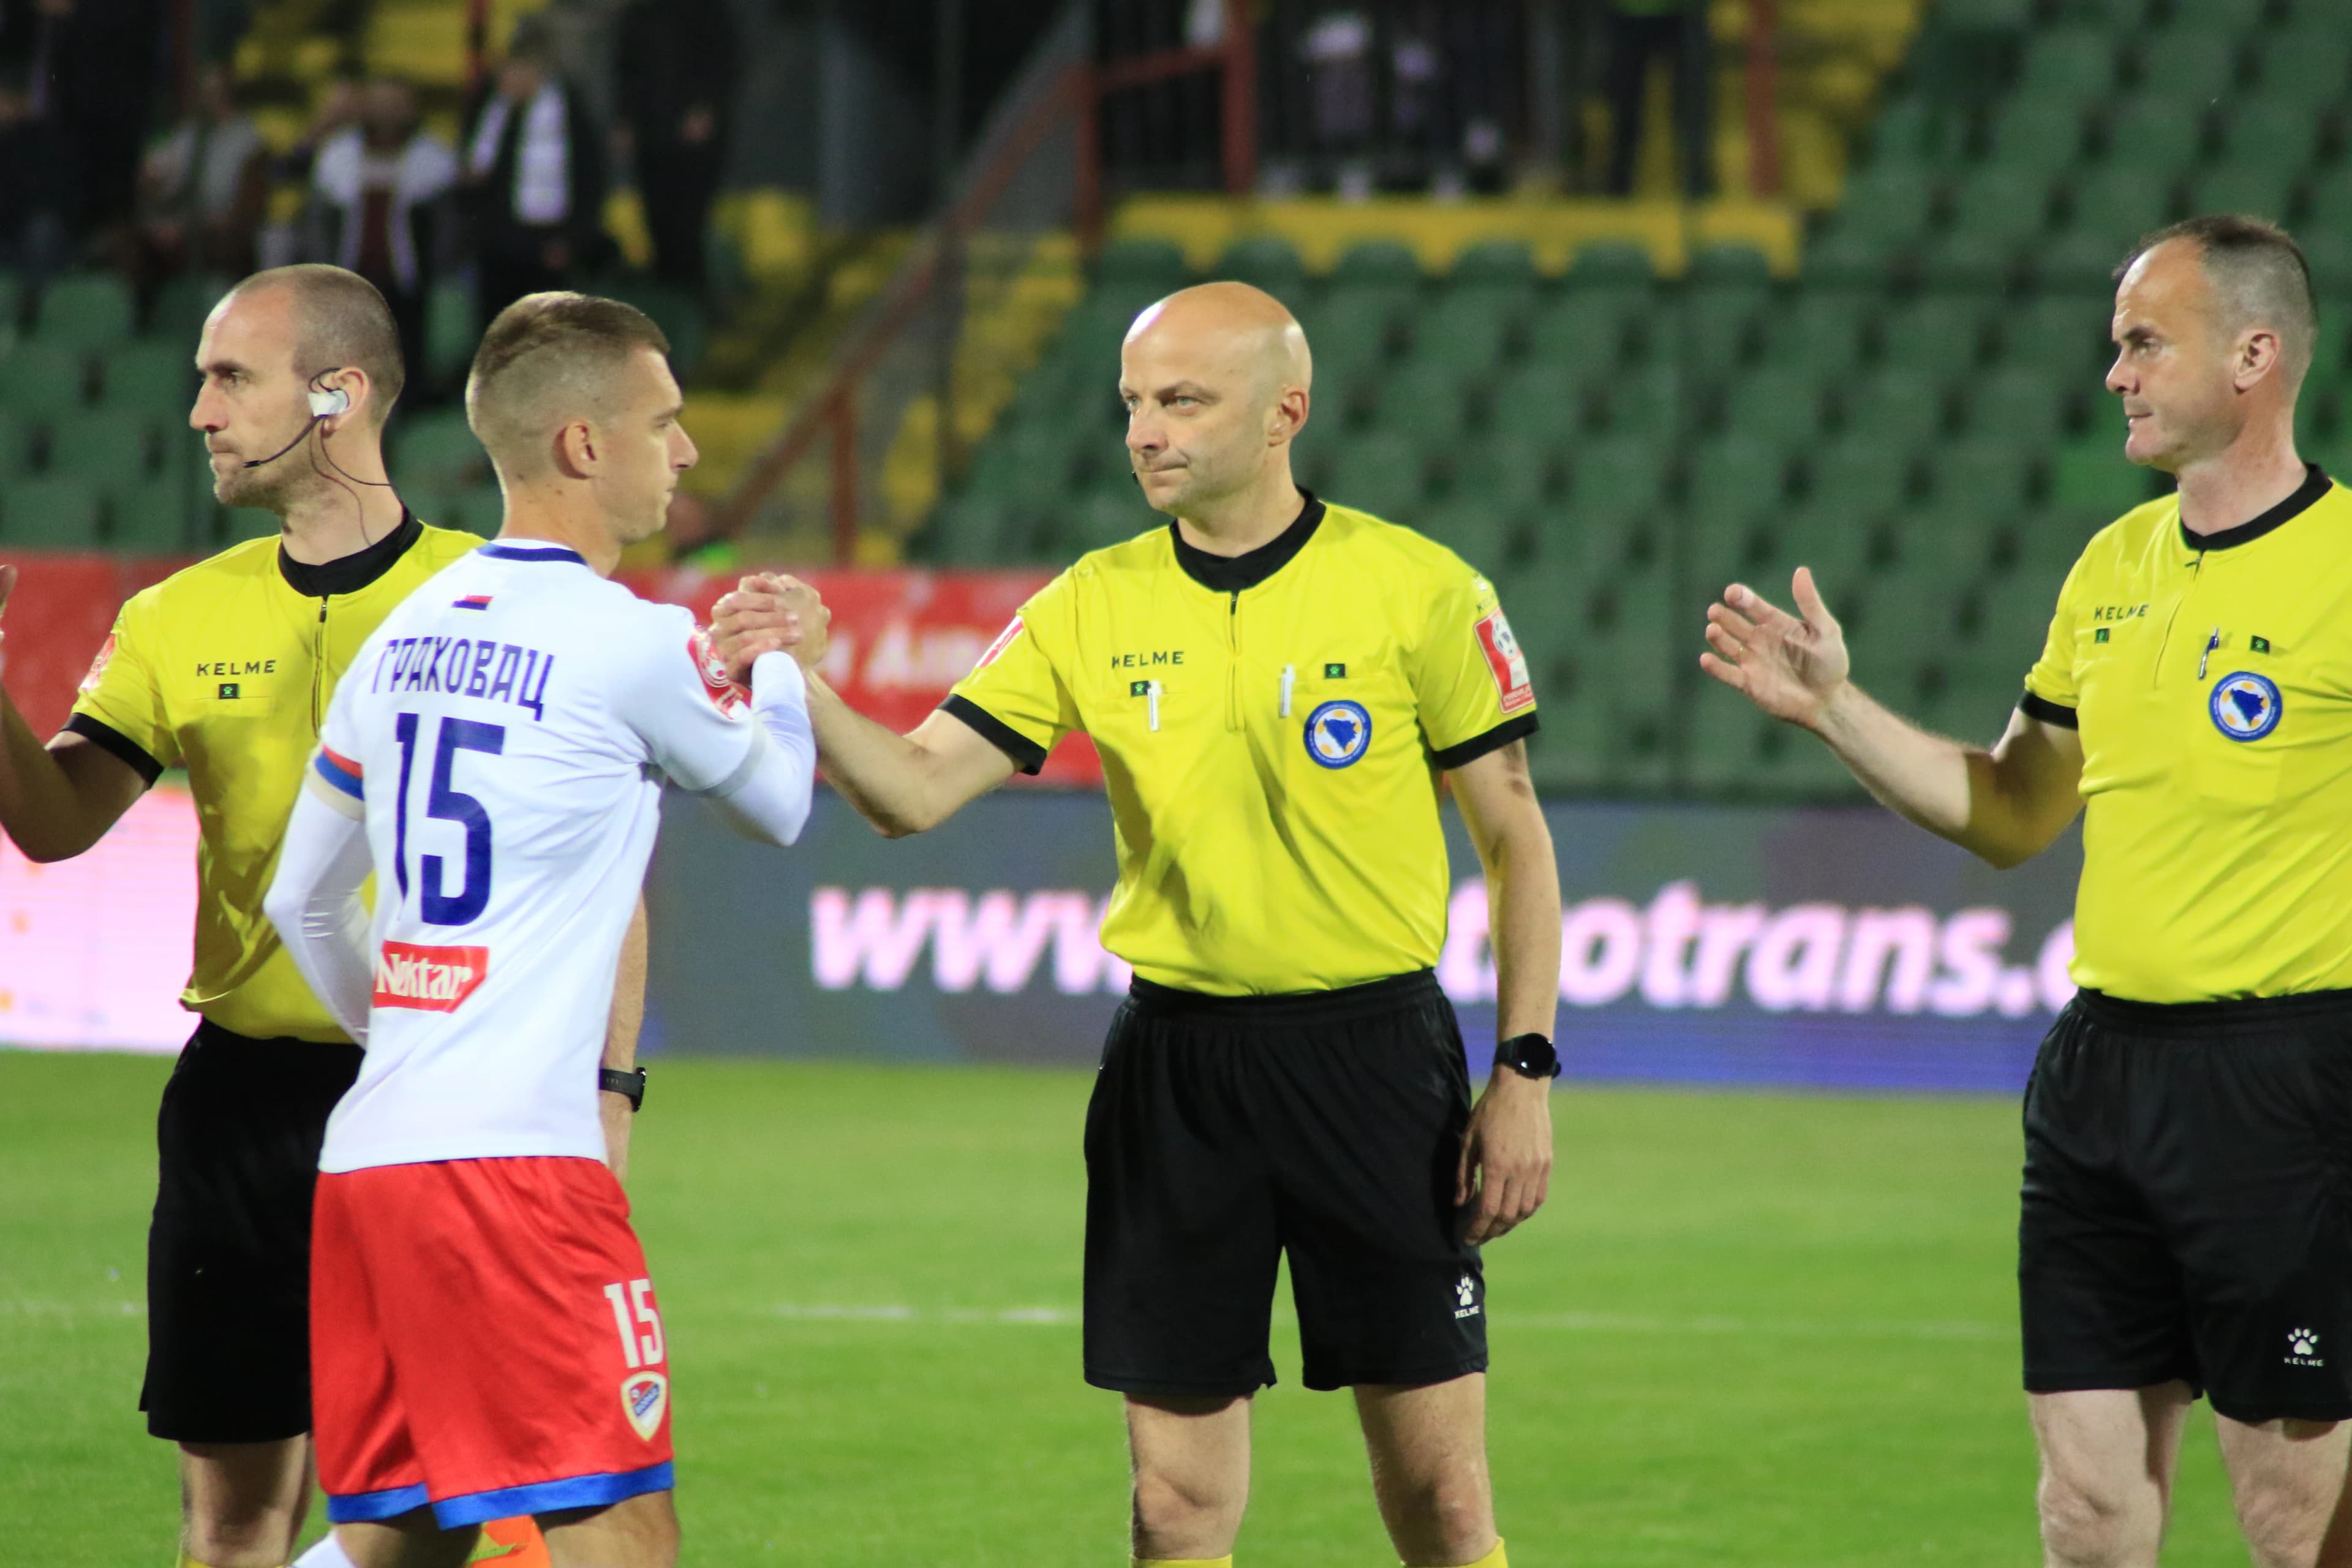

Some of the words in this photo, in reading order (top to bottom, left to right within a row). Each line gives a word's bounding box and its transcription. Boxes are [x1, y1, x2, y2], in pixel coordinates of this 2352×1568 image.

[2093, 604, 2149, 621] KELME
[197, 660, 276, 677] KELME
[1111, 650, 1185, 669] KELME
[371, 636, 555, 722] ГРАКОВАЦ
[395, 712, 506, 926] 15
[1454, 1305, 1480, 1319] KELME
[603, 1278, 664, 1369] 15
[2283, 1357, 2324, 1367] KELME
